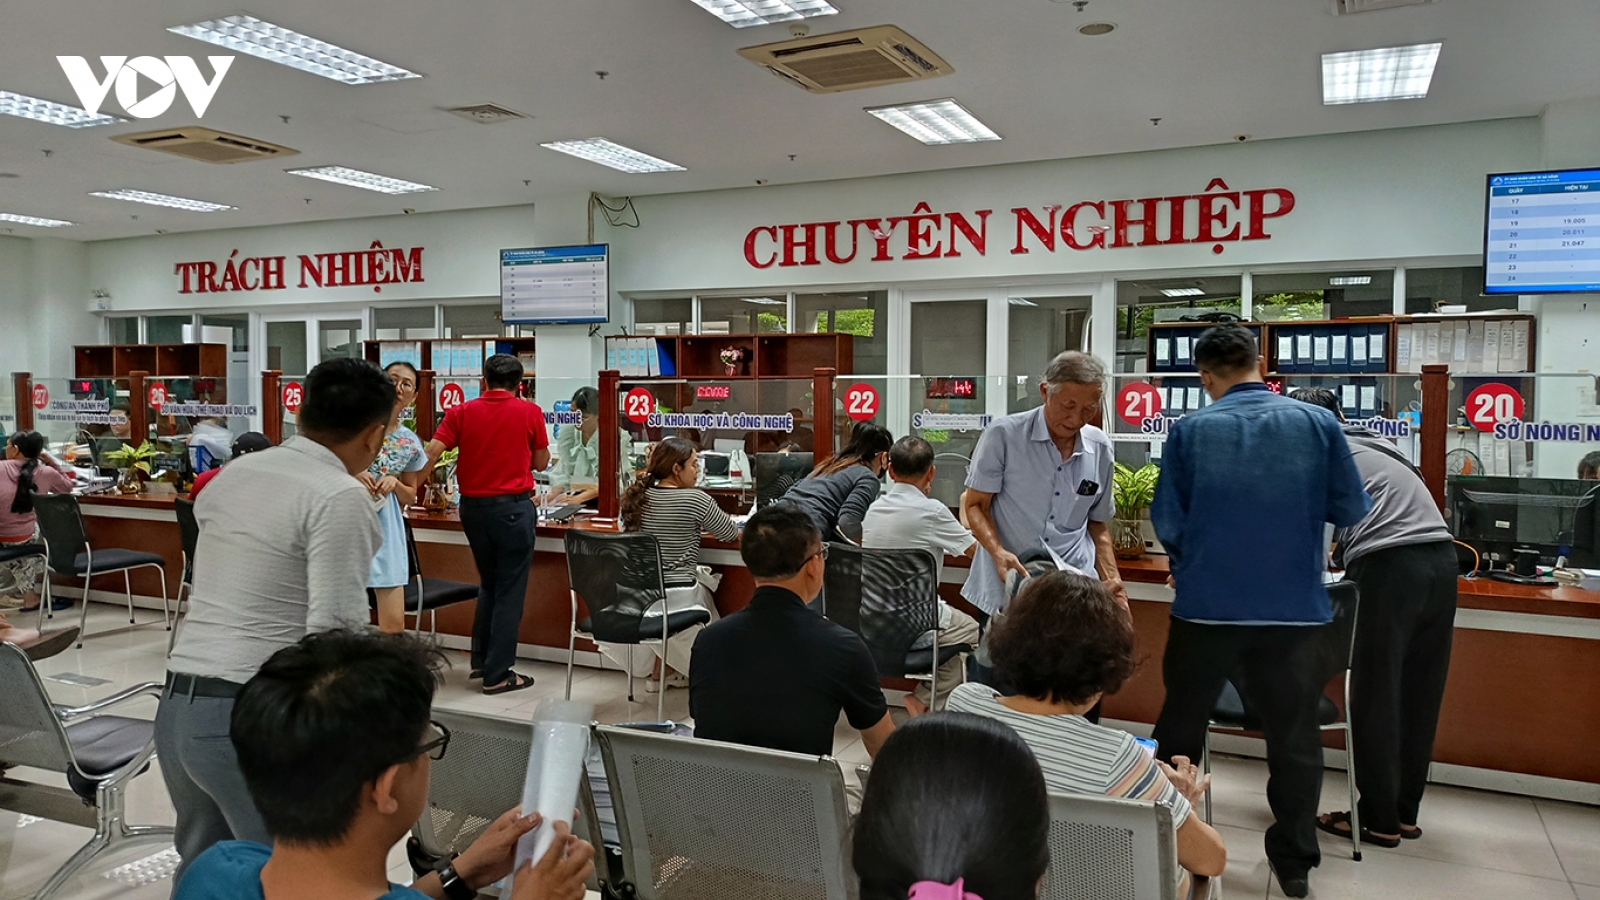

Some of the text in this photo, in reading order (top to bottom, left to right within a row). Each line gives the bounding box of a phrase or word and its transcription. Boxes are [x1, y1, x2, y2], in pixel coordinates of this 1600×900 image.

[743, 177, 1296, 269] CHUYÊN NGHIỆP
[173, 239, 425, 294] TRÁCH NHIỆM
[34, 389, 47, 405] 27
[151, 388, 164, 405] 26
[286, 388, 301, 406] 25
[443, 390, 461, 409] 24
[628, 395, 650, 416] 23
[849, 390, 875, 414] 22
[1125, 391, 1154, 417] 21
[557, 409, 582, 427] NGHỆ
[1474, 393, 1514, 422] 20
[648, 411, 793, 432] SỞ KHOA HỌC VÀ CÔNG NGHỆ
[1142, 414, 1163, 433] SỞ
[1495, 418, 1520, 440] SỞ
[1525, 421, 1580, 441] NÔNG
